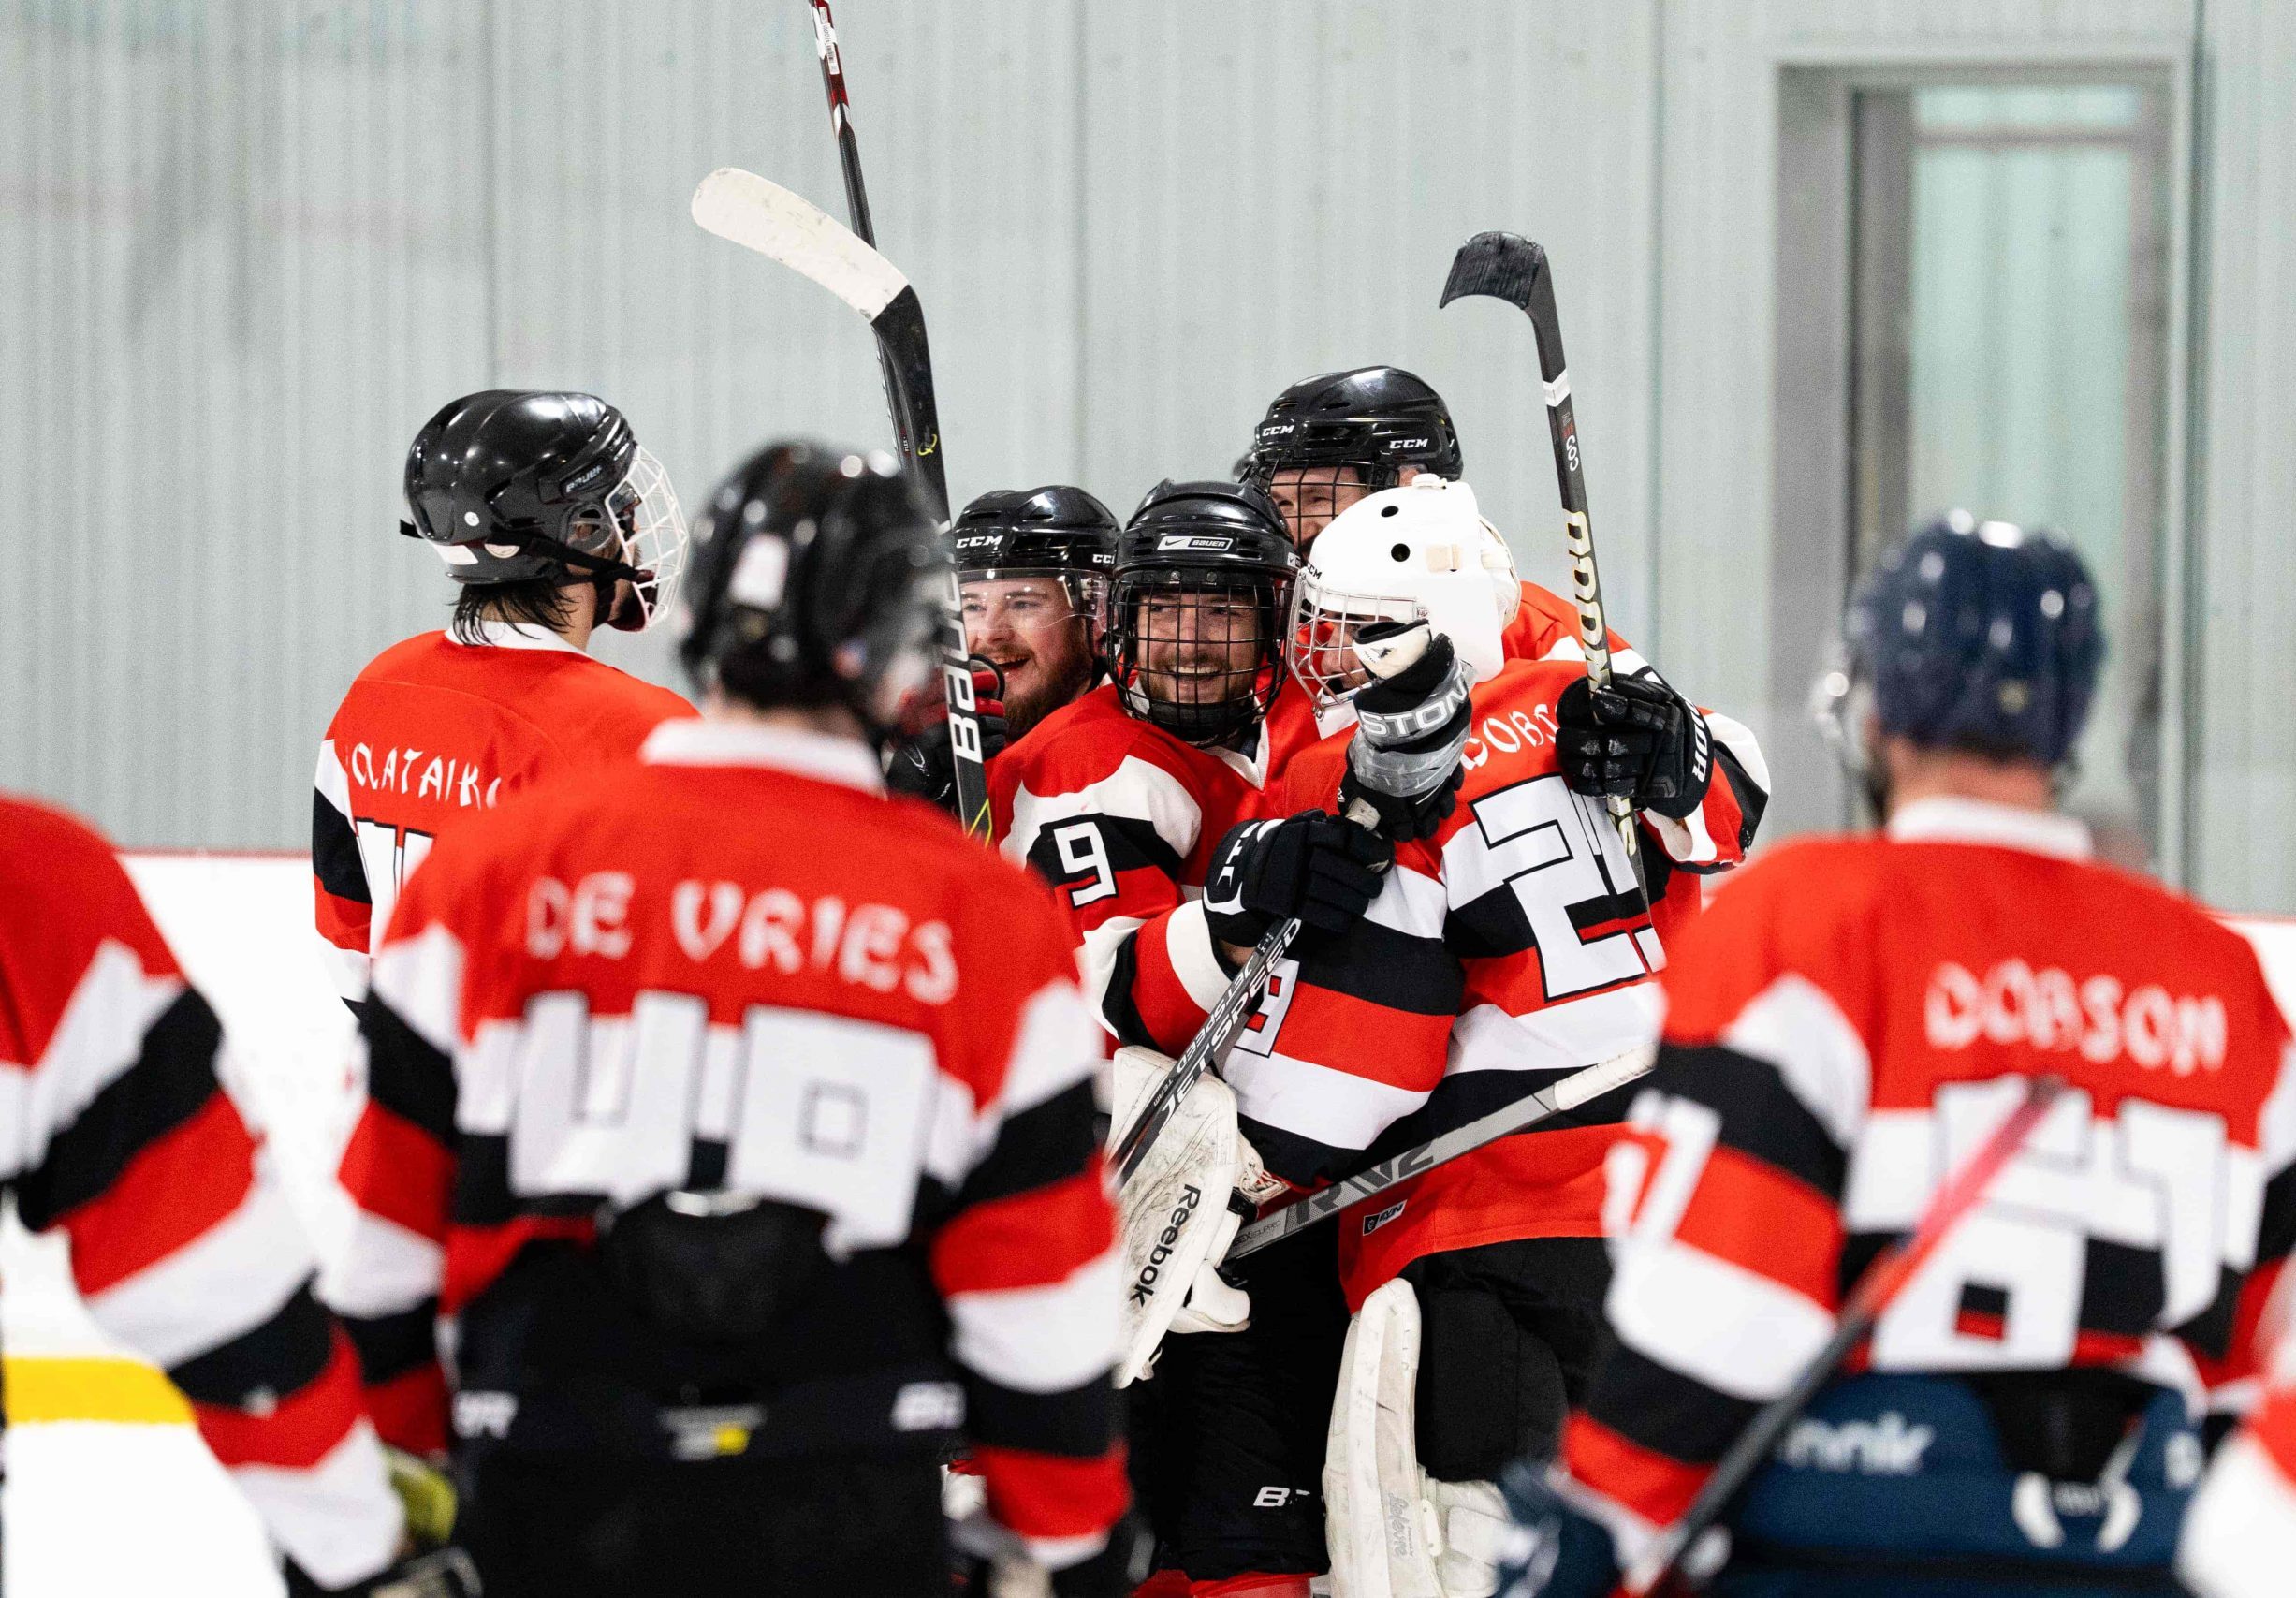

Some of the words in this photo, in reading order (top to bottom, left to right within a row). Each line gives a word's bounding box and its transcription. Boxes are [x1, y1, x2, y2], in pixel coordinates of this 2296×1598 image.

[1262, 424, 1295, 437] CCM
[1389, 438, 1428, 449] CCM
[956, 535, 1004, 550] CCM
[1092, 553, 1115, 564] CC
[1308, 563, 1323, 580] CM
[1052, 820, 1119, 909] 9
[525, 870, 637, 962] DE
[670, 879, 959, 1004] VRIES
[1159, 918, 1302, 1136] JETSPEED
[1177, 954, 1255, 1075] JETSPEED
[1923, 957, 2230, 1078] DOBSON
[1128, 1183, 1202, 1308] Reebok
